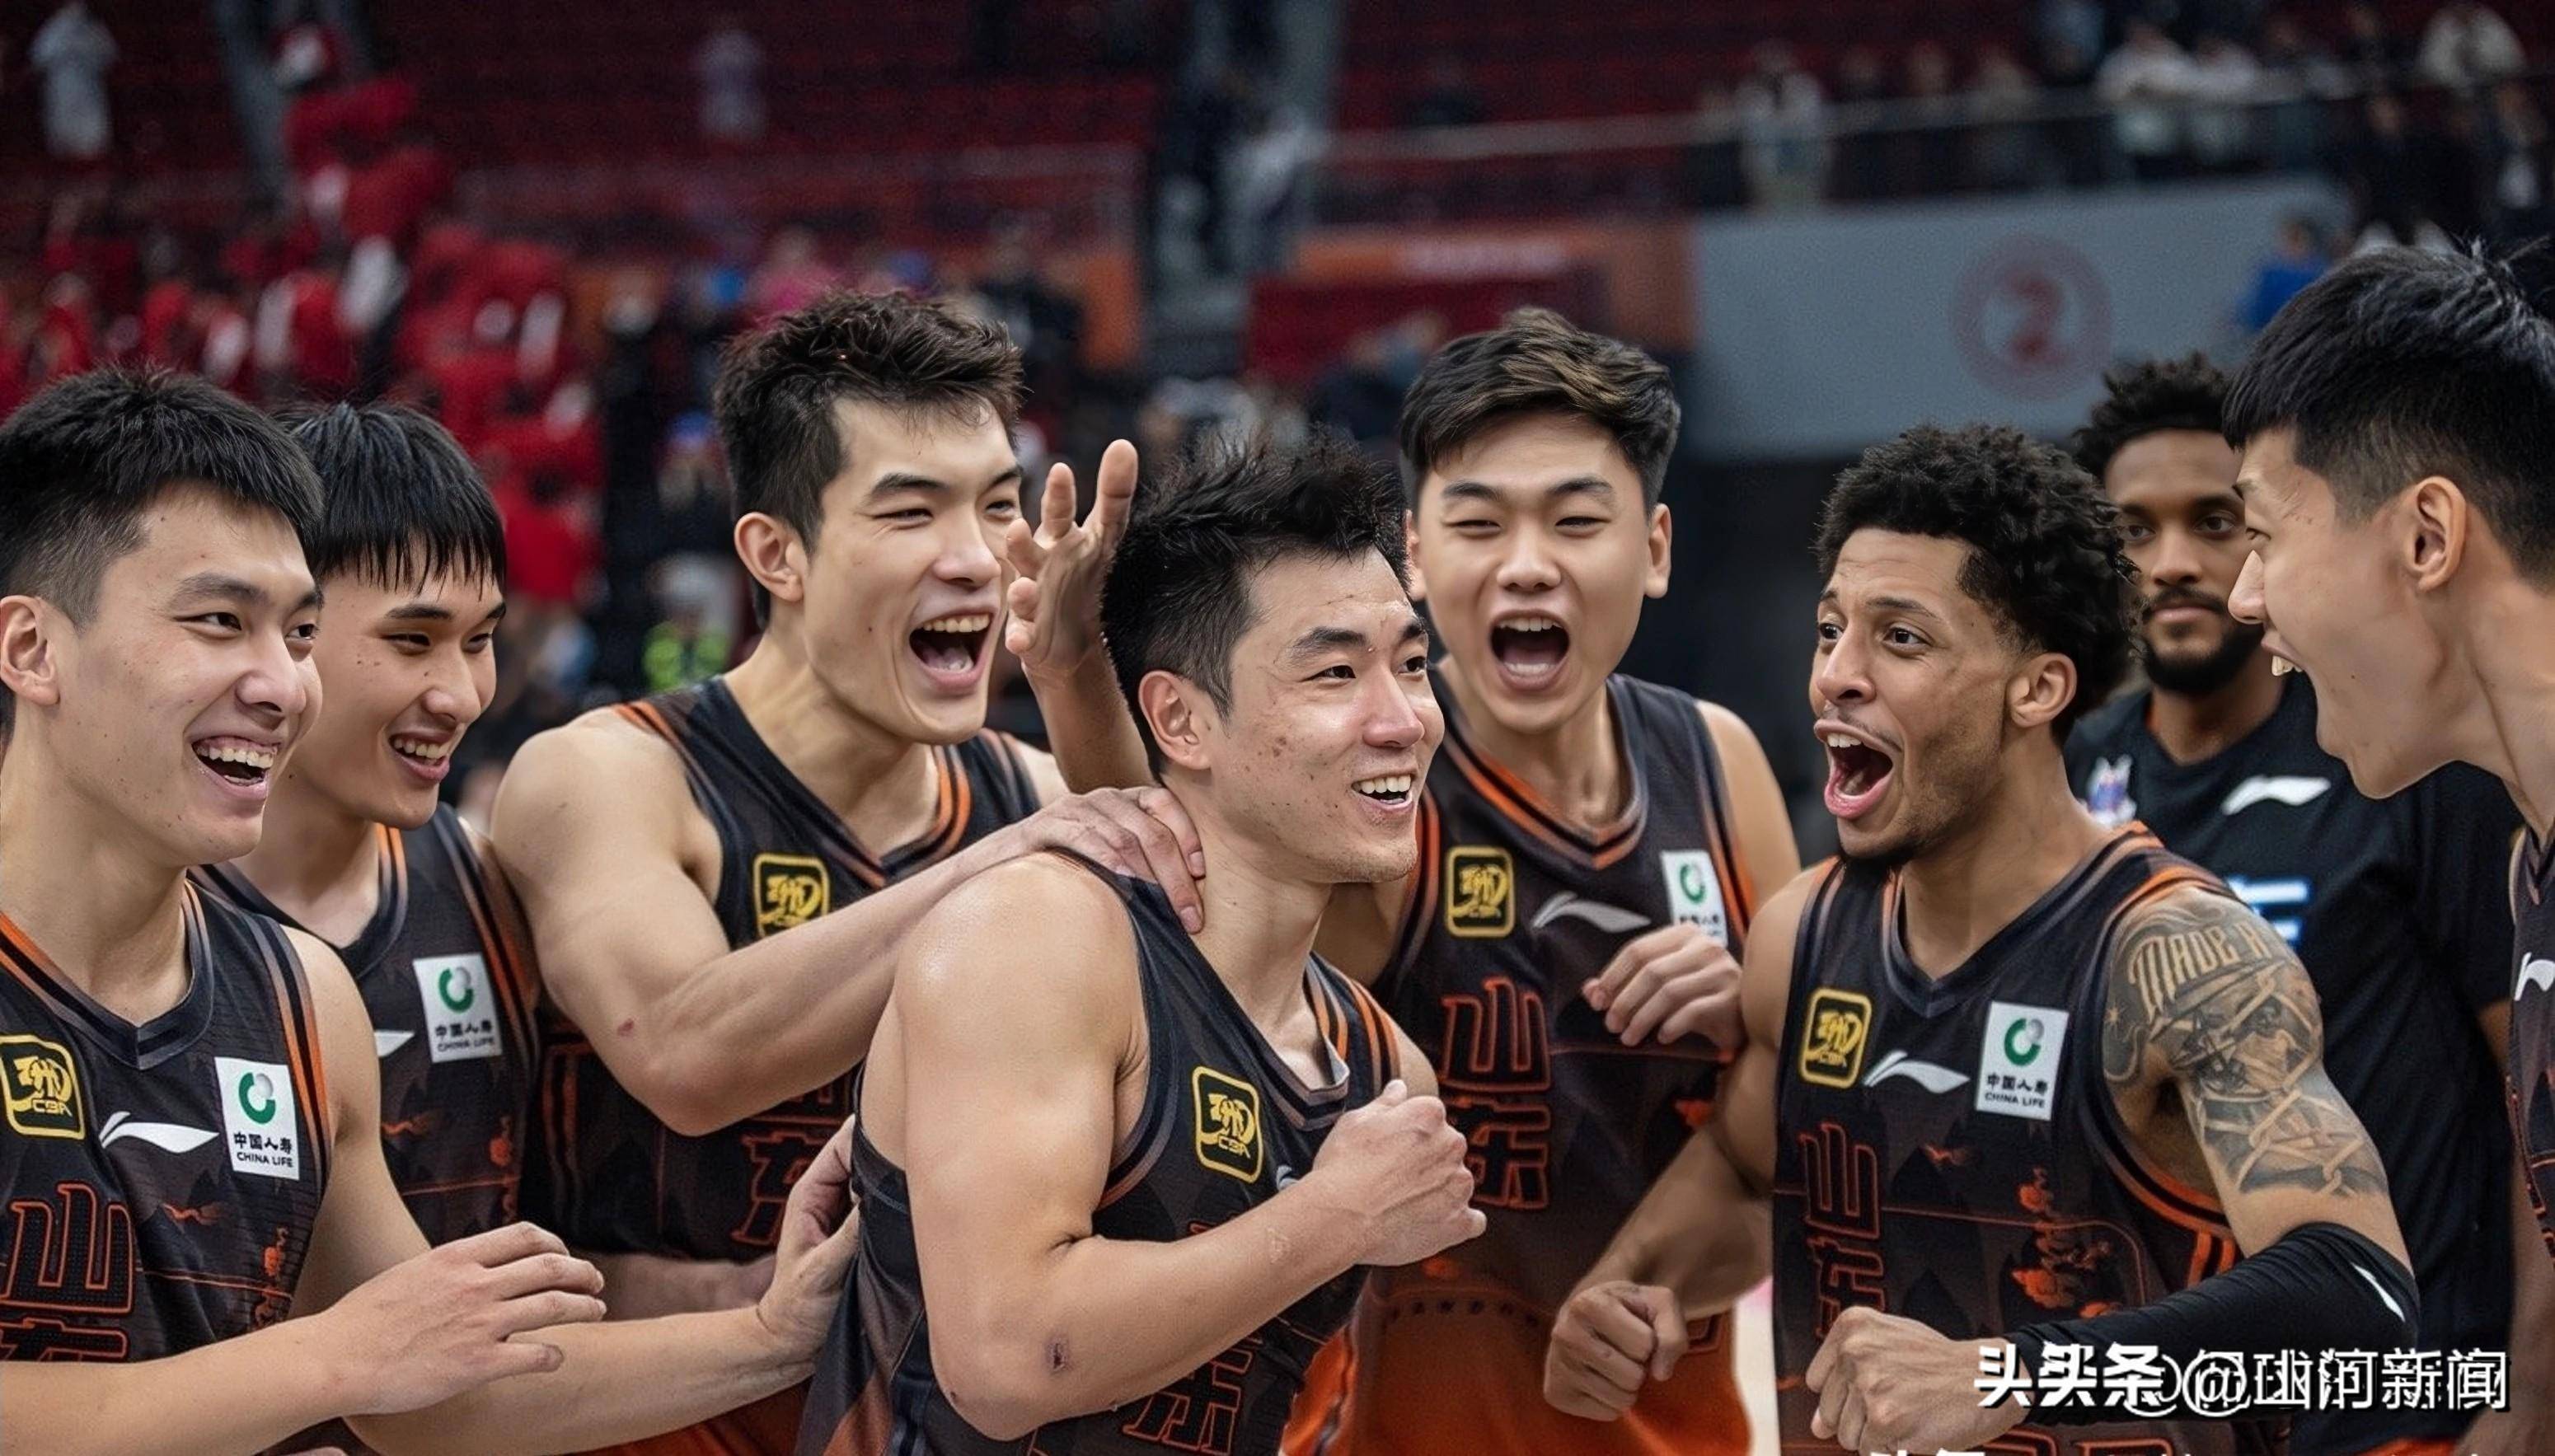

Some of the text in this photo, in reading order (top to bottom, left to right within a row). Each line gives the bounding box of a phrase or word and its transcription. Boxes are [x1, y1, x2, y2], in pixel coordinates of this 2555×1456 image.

[1986, 1073, 2047, 1097] 中国人寿
[1985, 1092, 2045, 1108] CHINA LIFE
[233, 1131, 293, 1154] 中国人寿
[237, 1152, 293, 1168] CHINA LIFE
